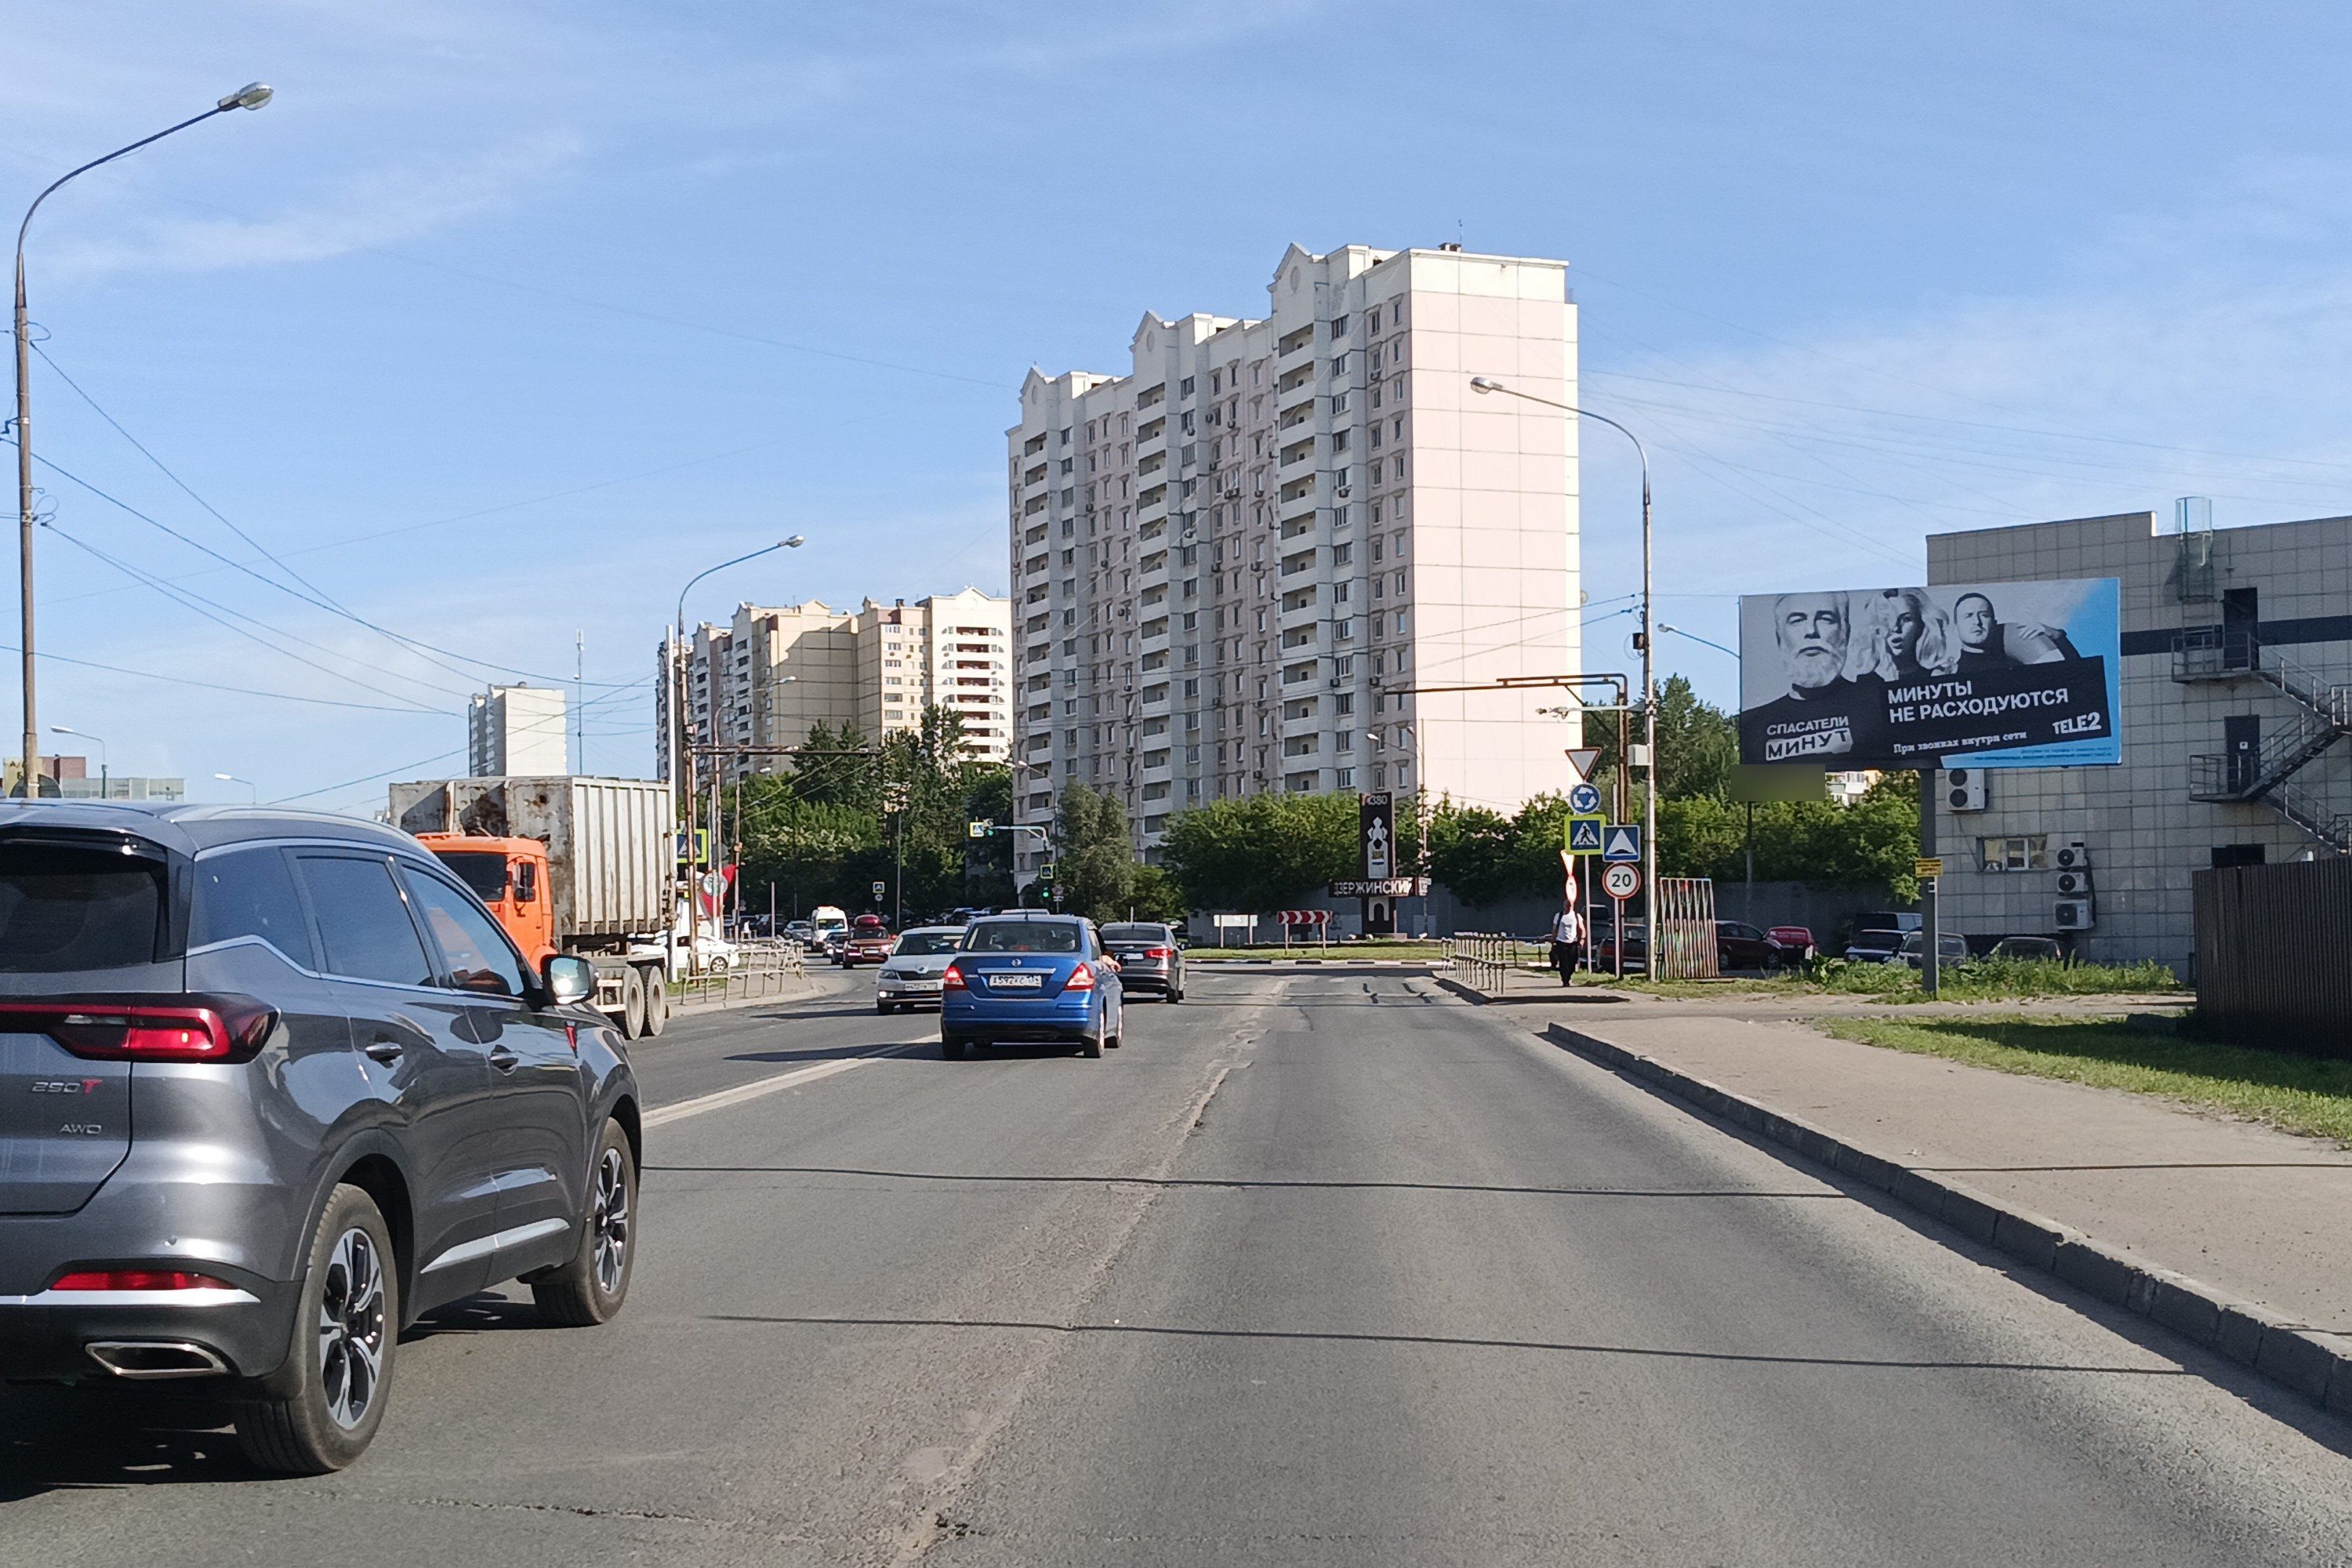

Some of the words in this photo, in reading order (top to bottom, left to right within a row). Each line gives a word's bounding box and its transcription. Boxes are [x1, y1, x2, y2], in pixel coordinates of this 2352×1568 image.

[1887, 681, 1973, 704] МИНУТЫ
[1889, 706, 1916, 723] НЕ
[1919, 688, 2069, 720] РАСХОДУЮТСЯ
[1766, 715, 1849, 735] СПАСАТЕЛИ
[2052, 711, 2102, 735] TELE2
[1767, 729, 1848, 758] МИНУТ
[1893, 743, 1915, 755] При
[1918, 739, 1959, 750] звонках
[1962, 734, 2000, 746] внутри
[2002, 731, 2027, 741] сети
[1611, 873, 1632, 887] 20
[31, 1079, 103, 1095] 250T
[59, 1123, 102, 1134] AWD
